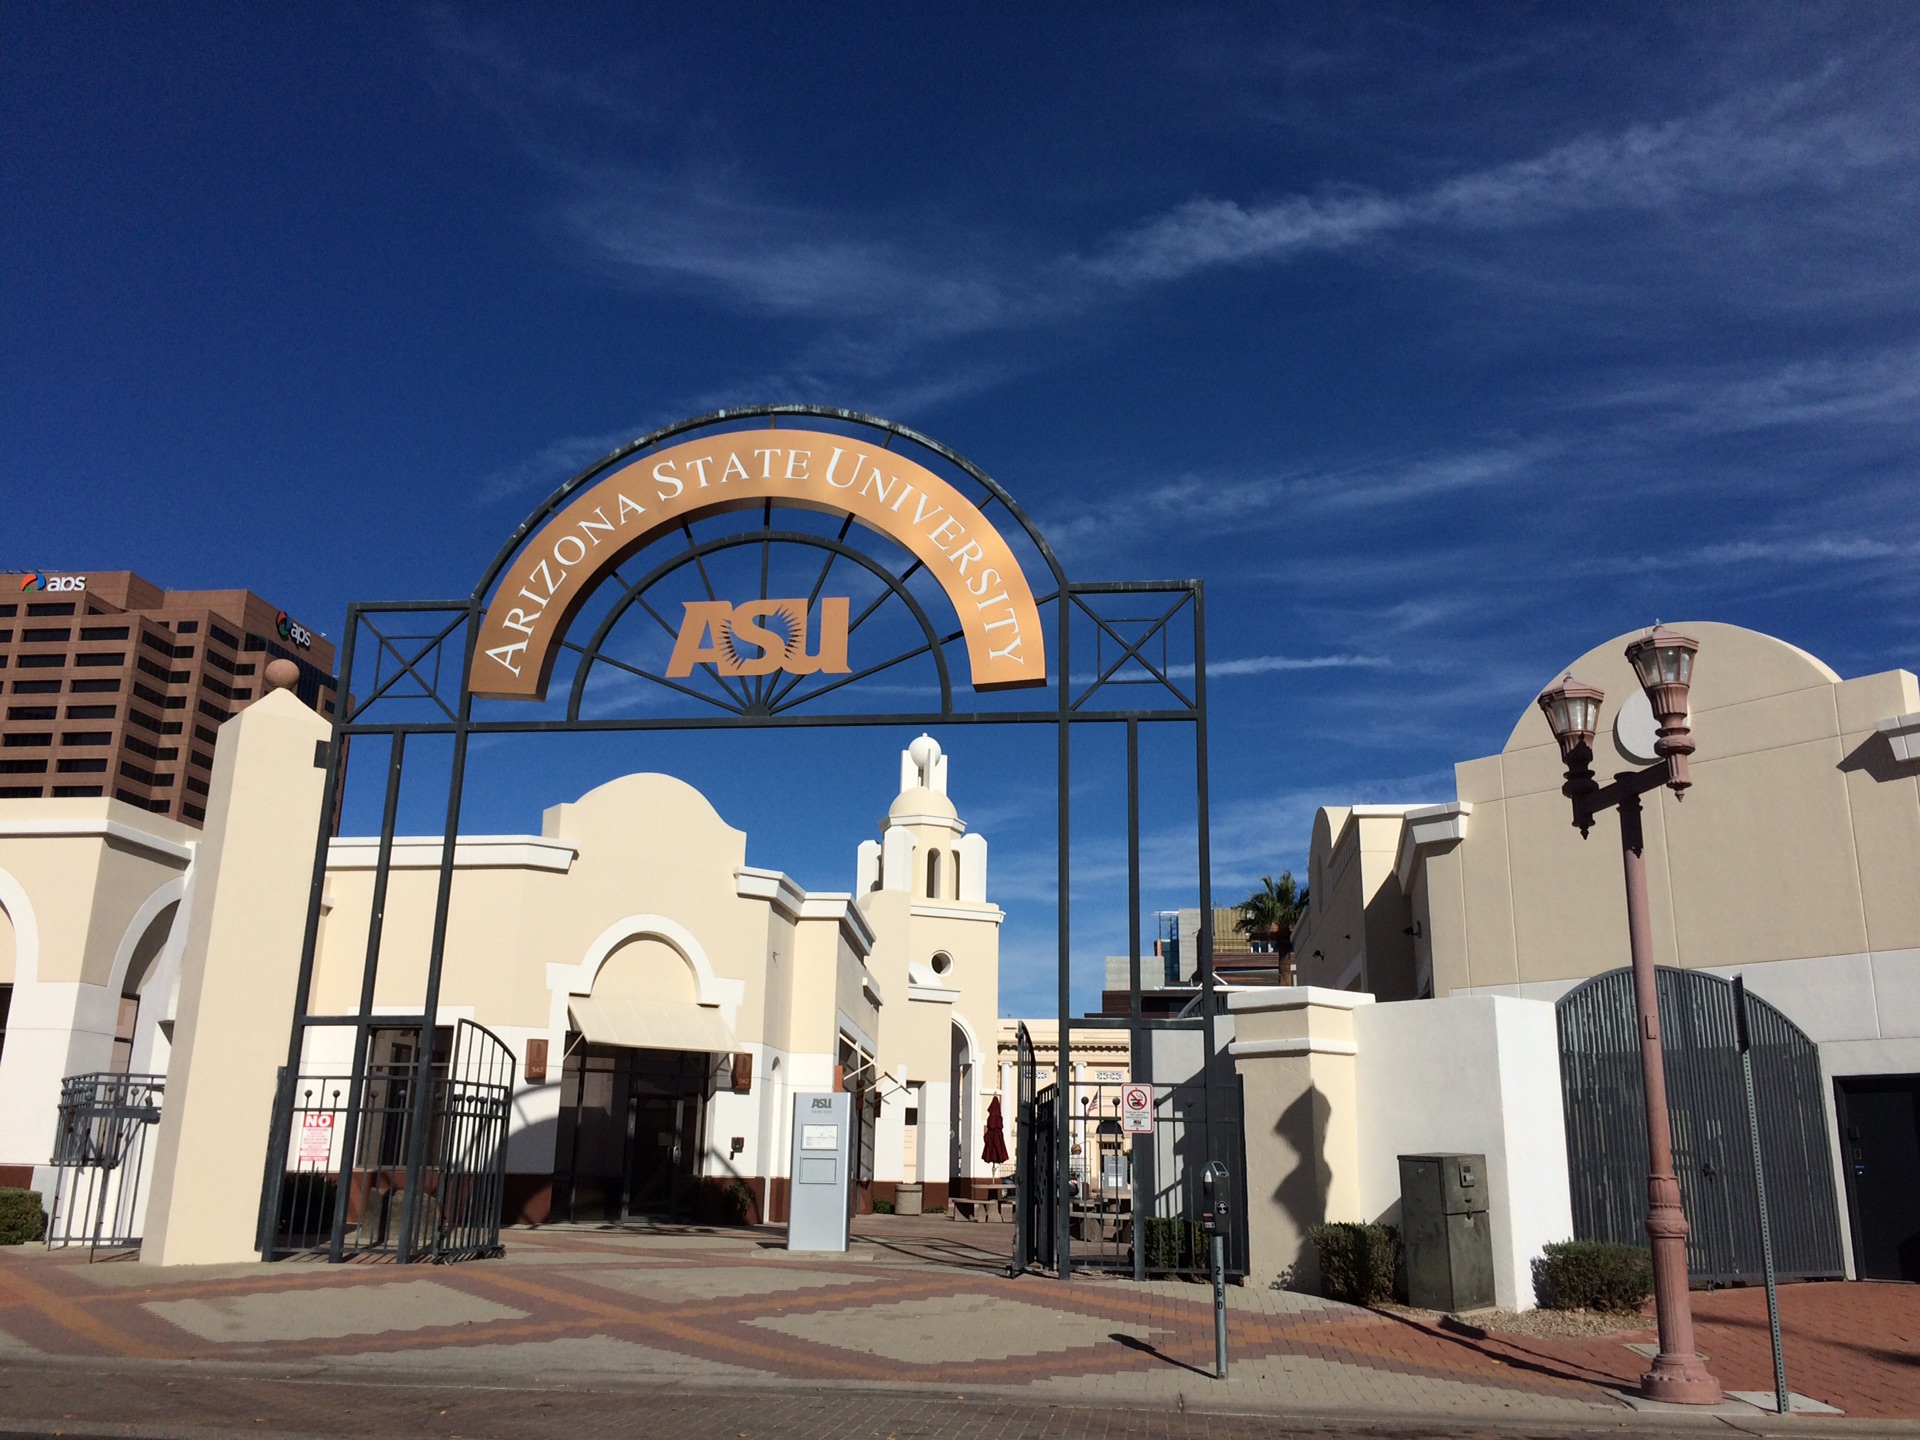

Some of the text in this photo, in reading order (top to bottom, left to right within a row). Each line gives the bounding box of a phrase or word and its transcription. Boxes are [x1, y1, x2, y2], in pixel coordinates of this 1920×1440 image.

[485, 446, 1025, 677] ARIZONA STATE UNIVERSITY
[46, 576, 86, 591] aps
[290, 623, 310, 646] aps
[665, 596, 853, 677] ASU
[811, 1098, 832, 1109] ASU
[305, 1115, 331, 1127] NO
